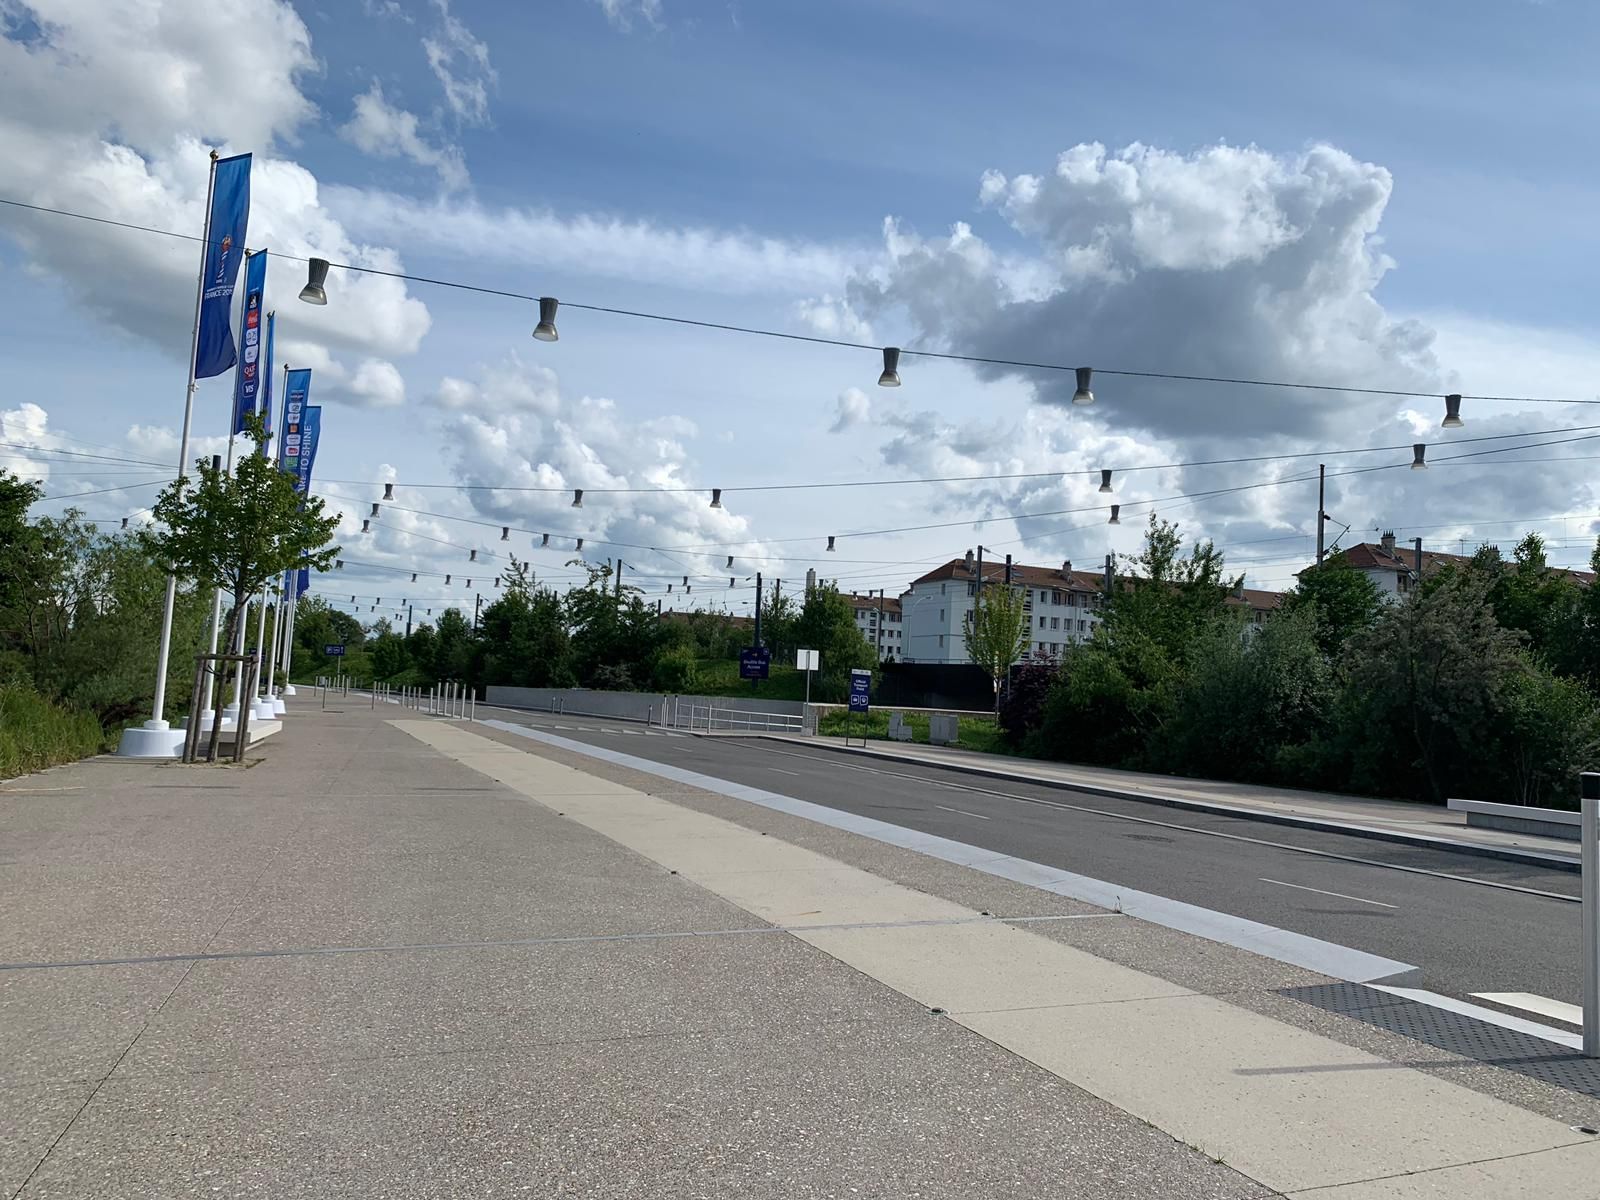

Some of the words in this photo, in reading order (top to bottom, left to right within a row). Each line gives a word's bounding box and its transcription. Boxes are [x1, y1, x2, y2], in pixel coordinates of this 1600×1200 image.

[204, 289, 222, 300] FRANCE
[302, 424, 312, 457] SHINE
[300, 458, 309, 471] TO
